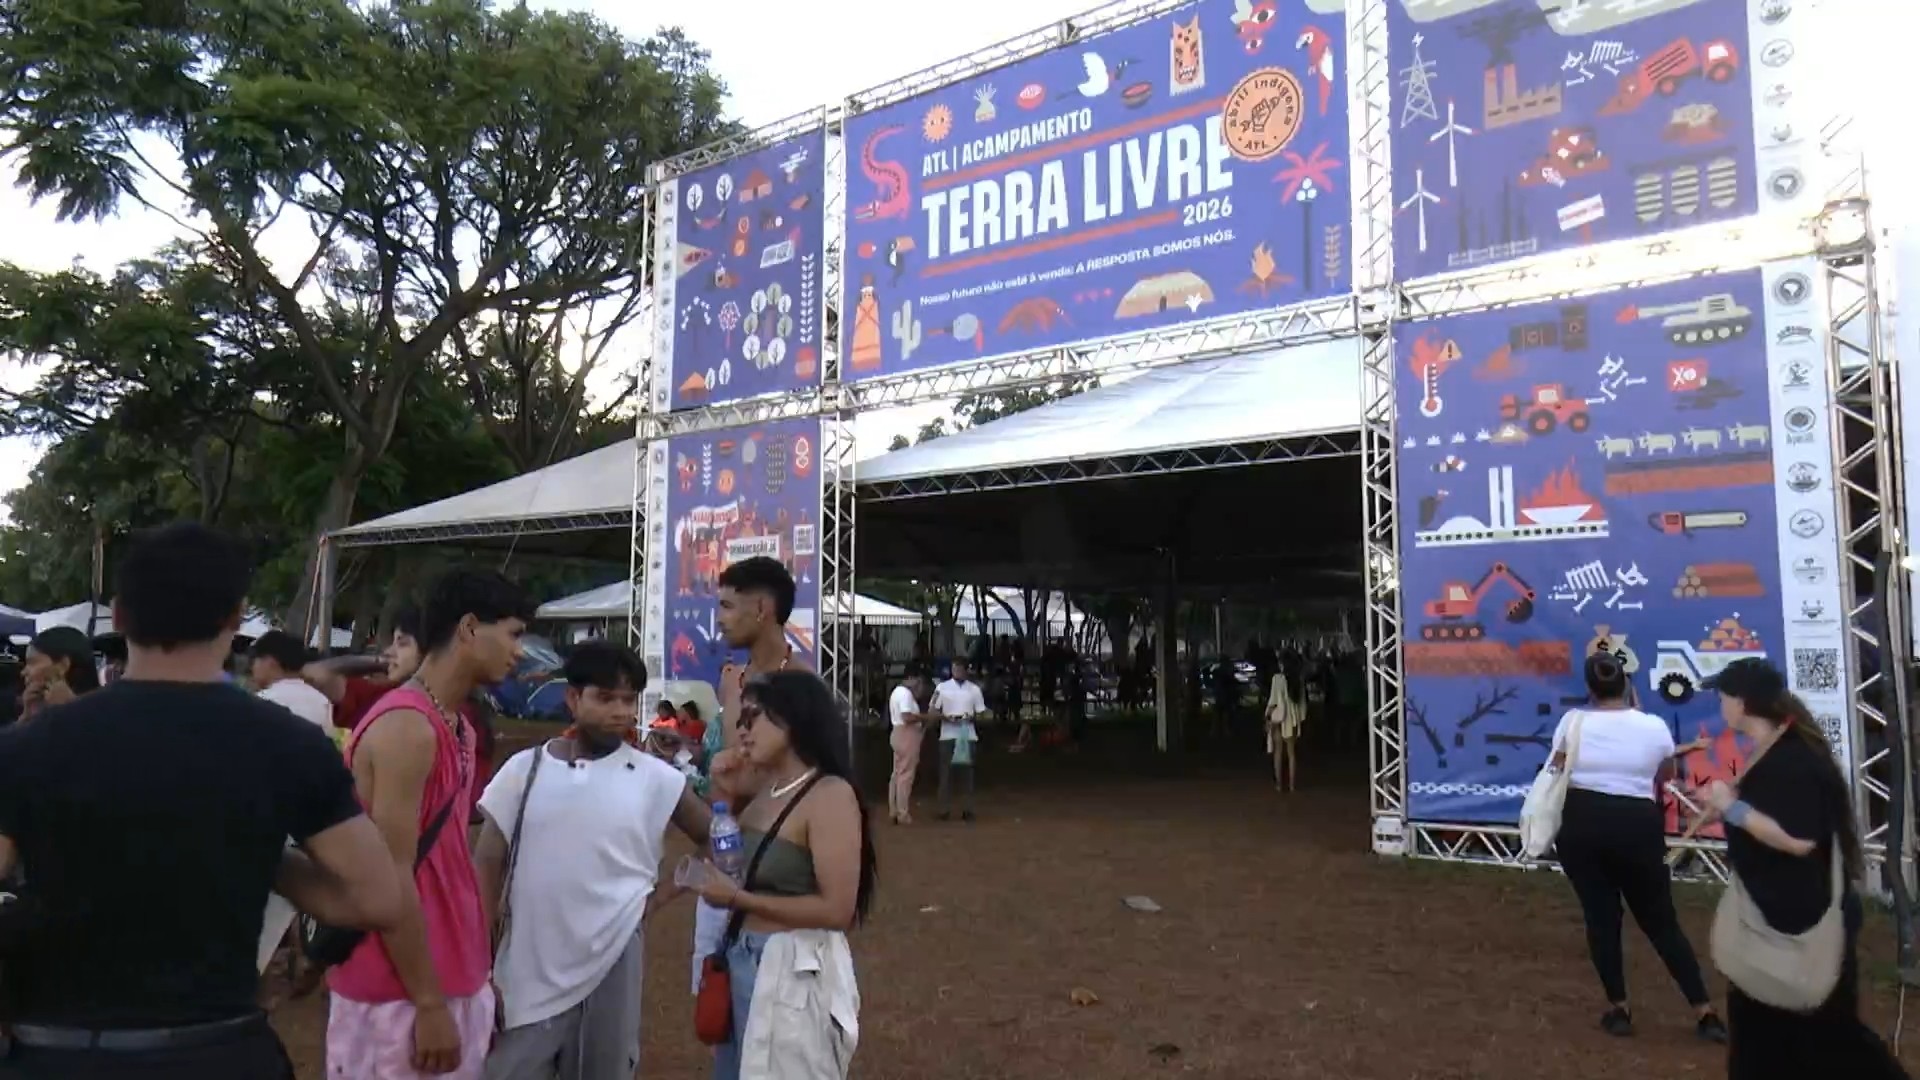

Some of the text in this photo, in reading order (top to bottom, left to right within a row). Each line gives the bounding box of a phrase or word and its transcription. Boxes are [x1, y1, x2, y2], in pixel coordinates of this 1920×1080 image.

[922, 149, 950, 177] ATL
[961, 106, 1093, 167] ACAMPAMENTO
[921, 115, 1234, 260] TERRA LIVRE
[1182, 195, 1233, 228] 2026
[1075, 261, 1085, 274] A
[1086, 247, 1151, 271] RESPOSTA
[1152, 234, 1201, 258] SOMOS
